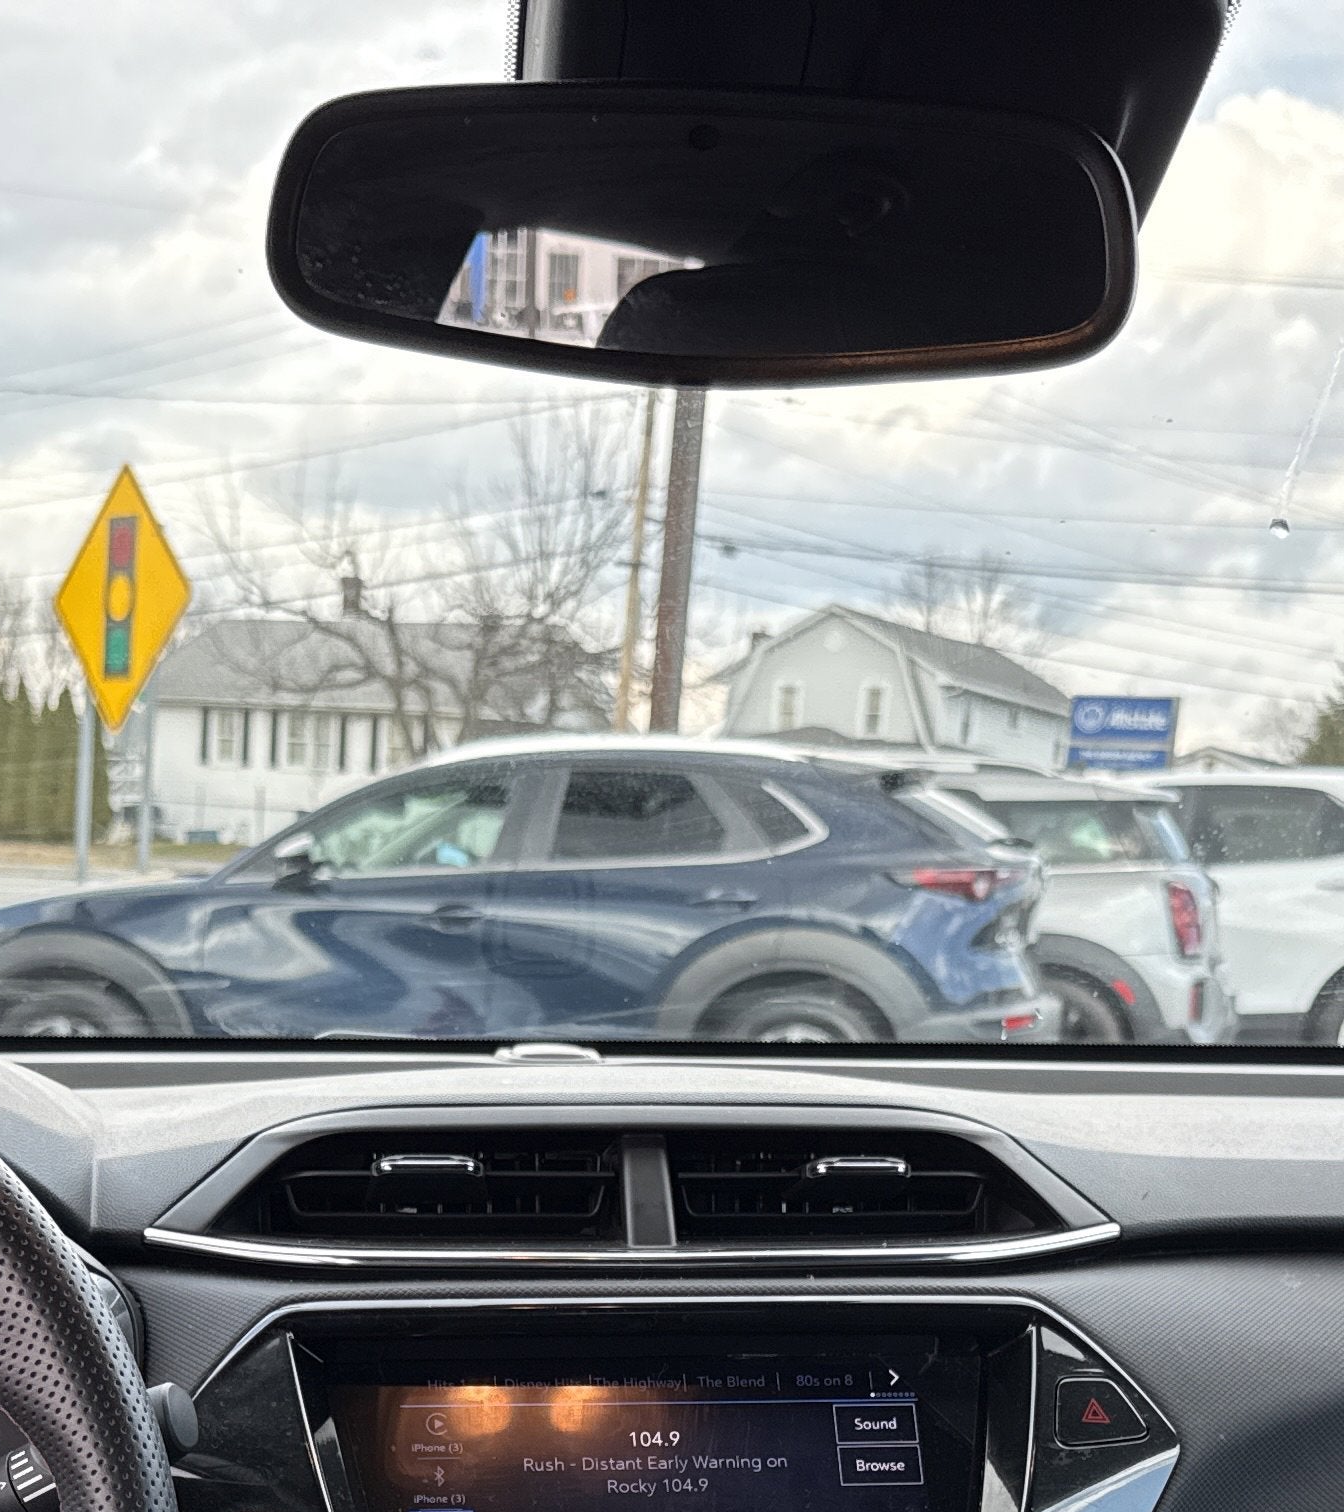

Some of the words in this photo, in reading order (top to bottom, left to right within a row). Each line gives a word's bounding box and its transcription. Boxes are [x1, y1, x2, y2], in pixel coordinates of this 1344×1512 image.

[594, 1377, 619, 1389] The
[623, 1377, 681, 1391] Highway
[697, 1376, 723, 1388] The
[727, 1375, 765, 1388] Blend
[796, 1375, 820, 1387] 80s
[824, 1378, 840, 1387] on
[844, 1374, 854, 1386] 8
[854, 1417, 897, 1431] Sound
[629, 1431, 680, 1447] 104.9
[411, 1443, 446, 1453] iPhone
[448, 1442, 464, 1454] (3)
[523, 1458, 565, 1472] Rush
[582, 1457, 642, 1471] Distant
[648, 1456, 688, 1474] Early
[694, 1456, 762, 1472] Warning
[767, 1457, 788, 1469] on
[855, 1459, 905, 1472] Browse
[607, 1479, 656, 1496] Rocky
[662, 1478, 709, 1493] 104.9
[413, 1494, 448, 1504] iPhone
[451, 1493, 466, 1505] (3)
